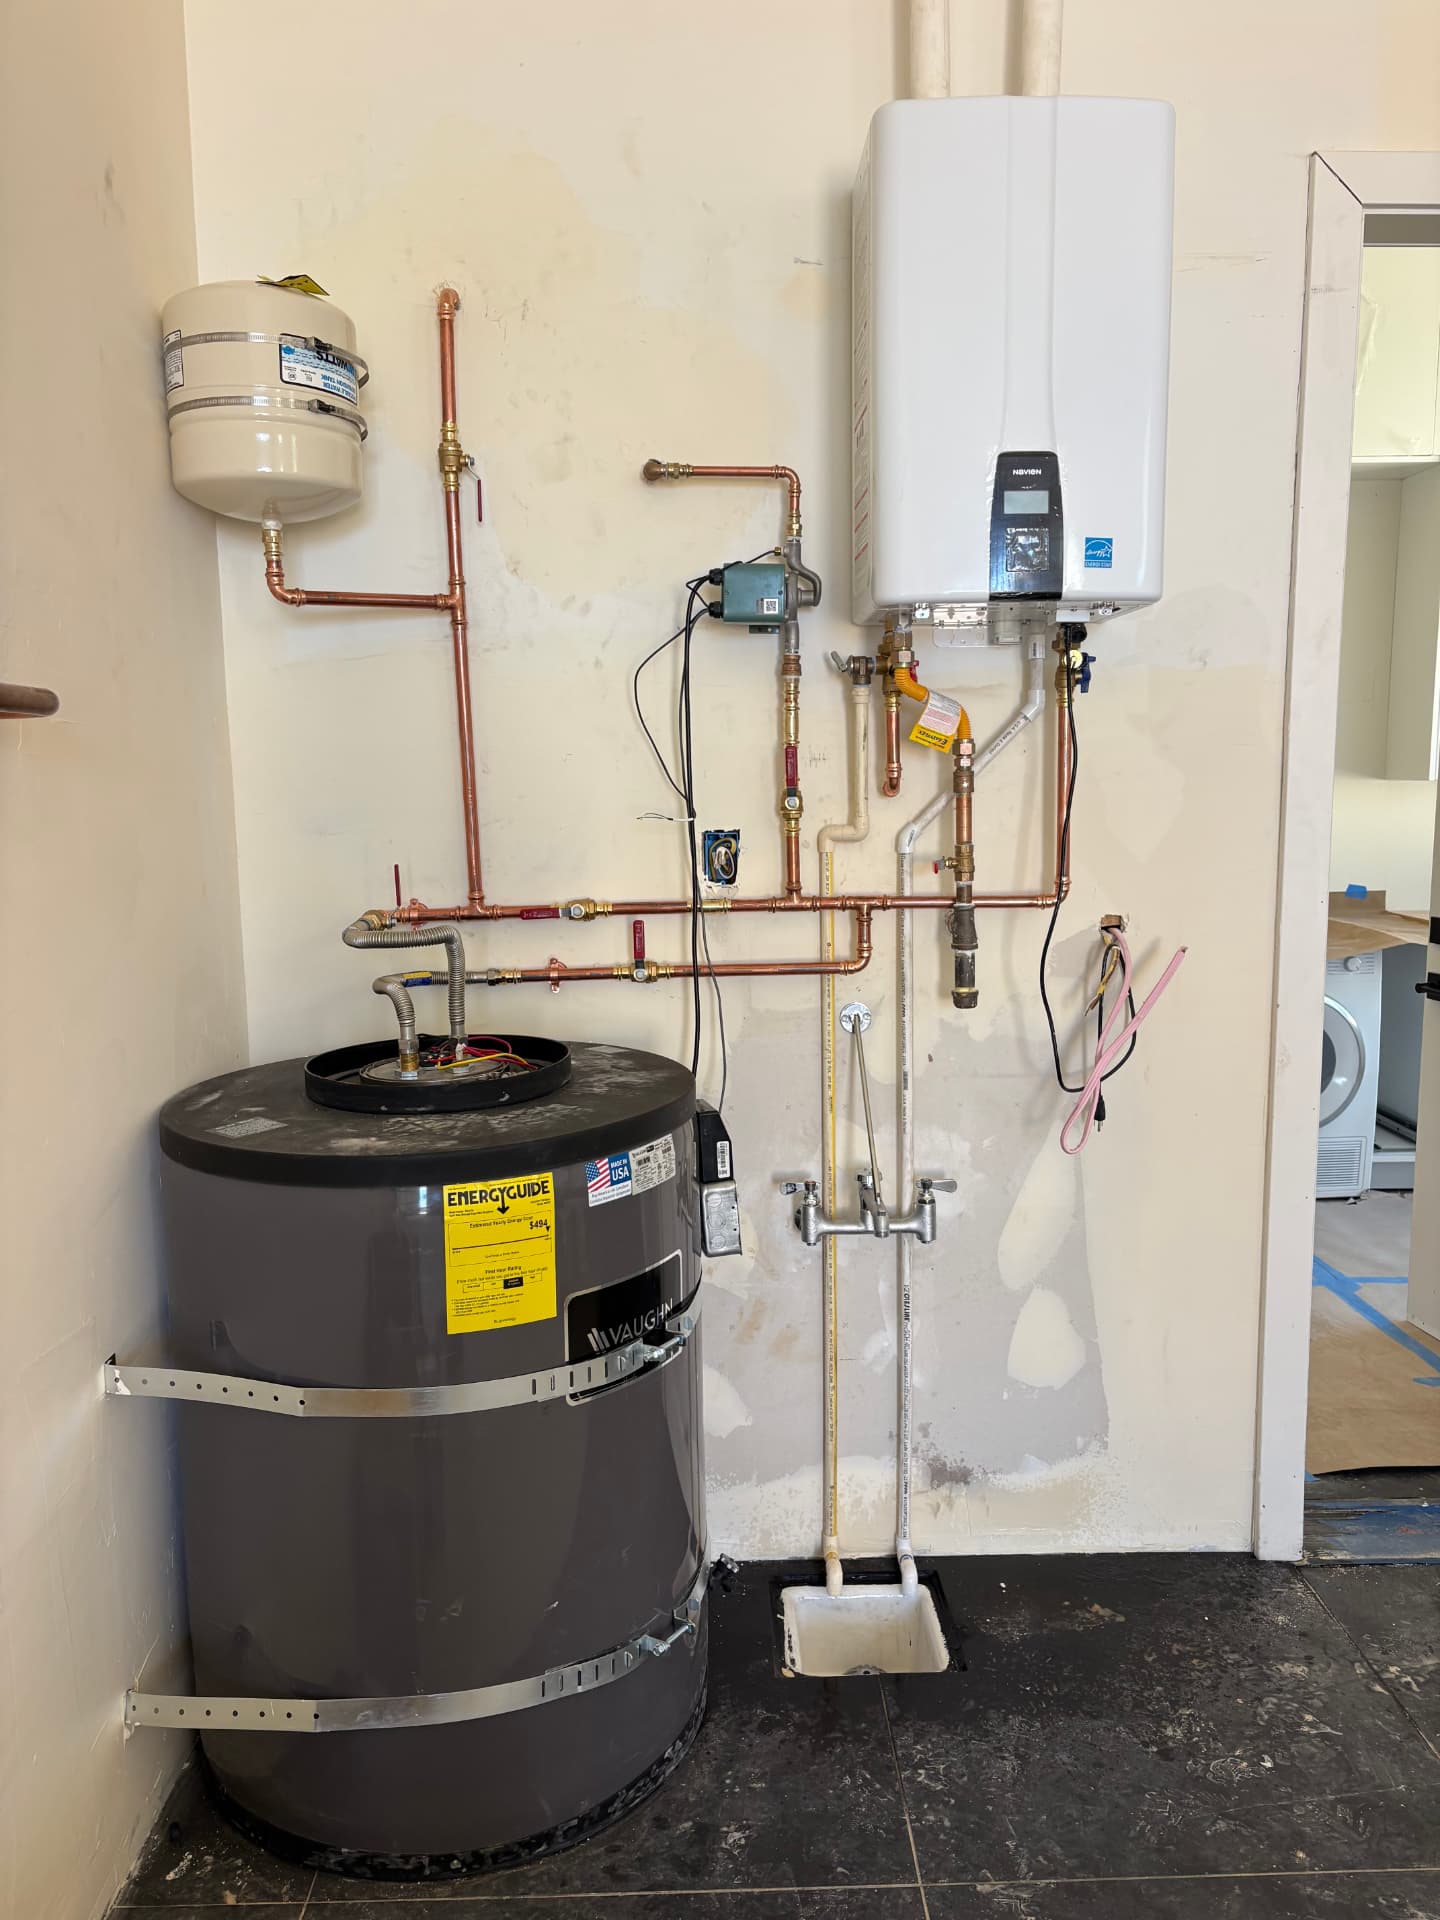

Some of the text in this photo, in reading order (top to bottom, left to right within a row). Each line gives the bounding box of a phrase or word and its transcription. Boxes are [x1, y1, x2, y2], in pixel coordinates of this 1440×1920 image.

[610, 1160, 622, 1169] MADE
[611, 1165, 630, 1181] USA
[447, 1180, 551, 1208] ENERGYGUIDE
[609, 1297, 673, 1345] VAUGHN
